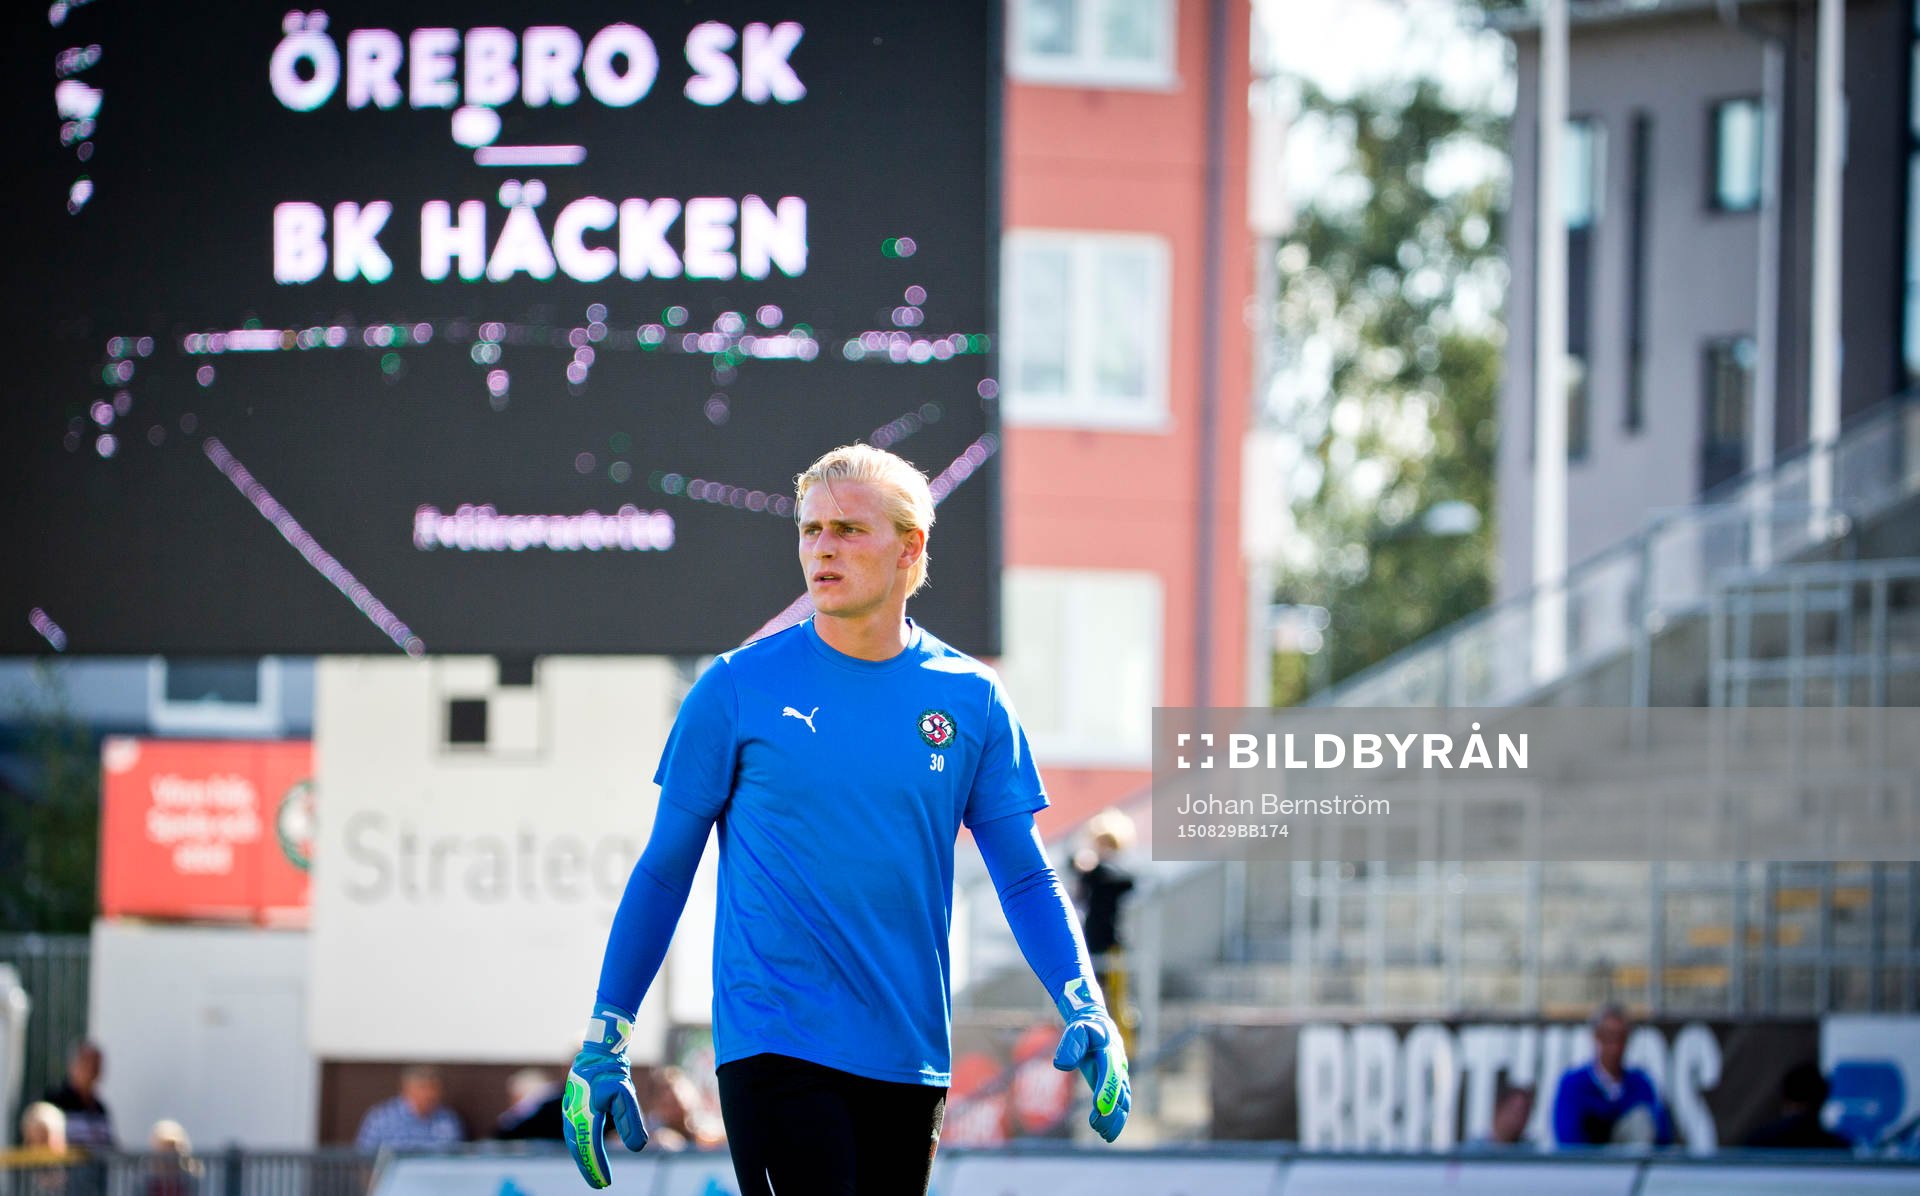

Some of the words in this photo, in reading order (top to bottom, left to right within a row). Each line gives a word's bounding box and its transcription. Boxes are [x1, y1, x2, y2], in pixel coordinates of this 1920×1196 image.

[269, 10, 658, 111] ÖREBRO
[684, 21, 807, 105] SK
[273, 201, 392, 284] BK
[419, 180, 808, 283] HÄCKEN
[929, 753, 945, 772] 30
